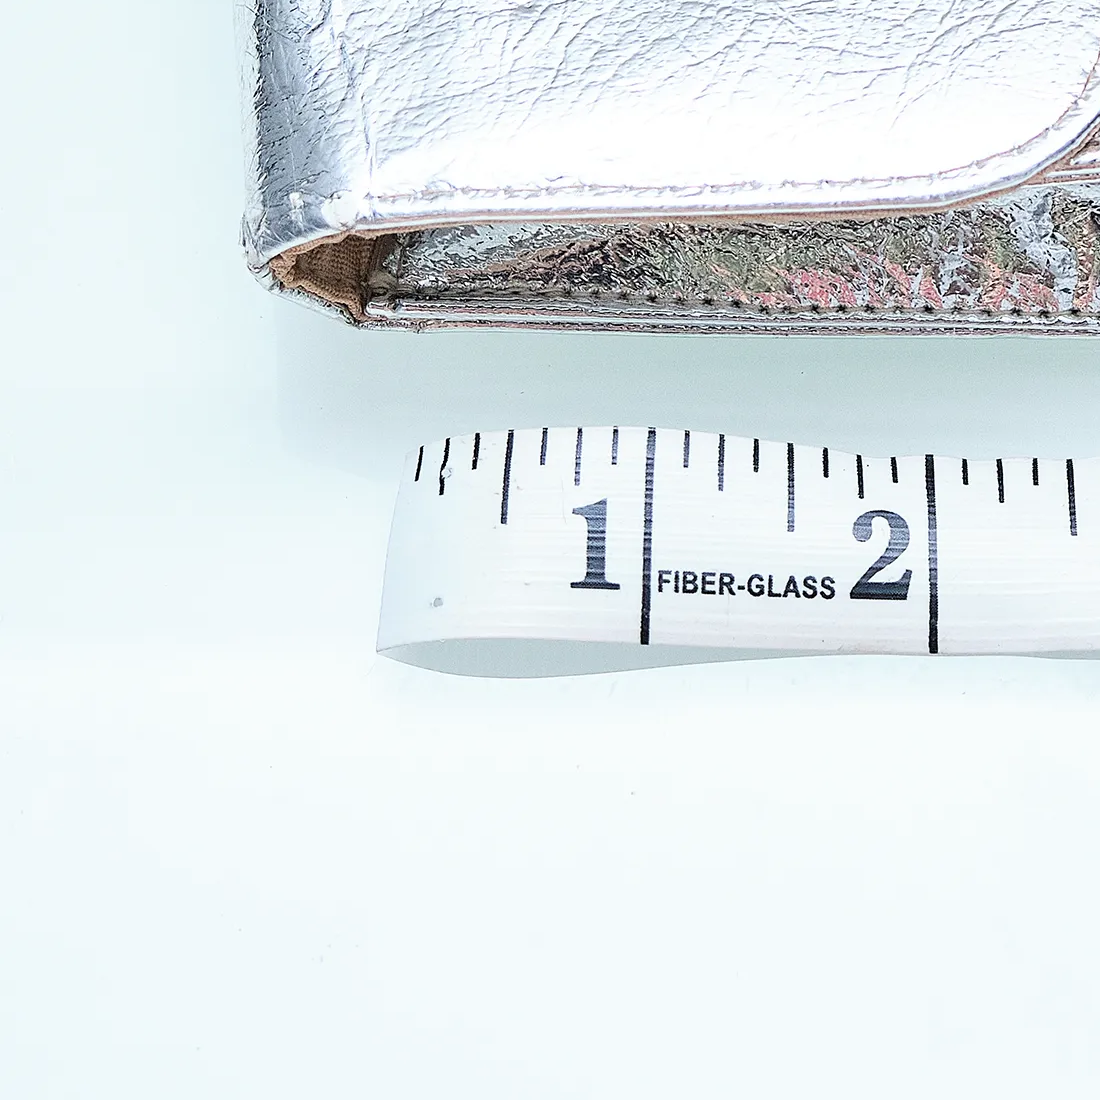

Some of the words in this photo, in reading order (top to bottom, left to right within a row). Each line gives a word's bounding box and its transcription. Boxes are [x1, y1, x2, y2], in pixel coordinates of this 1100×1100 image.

[569, 498, 621, 591] 1
[657, 569, 836, 601] FIBER-GLASS
[849, 509, 914, 601] 2
